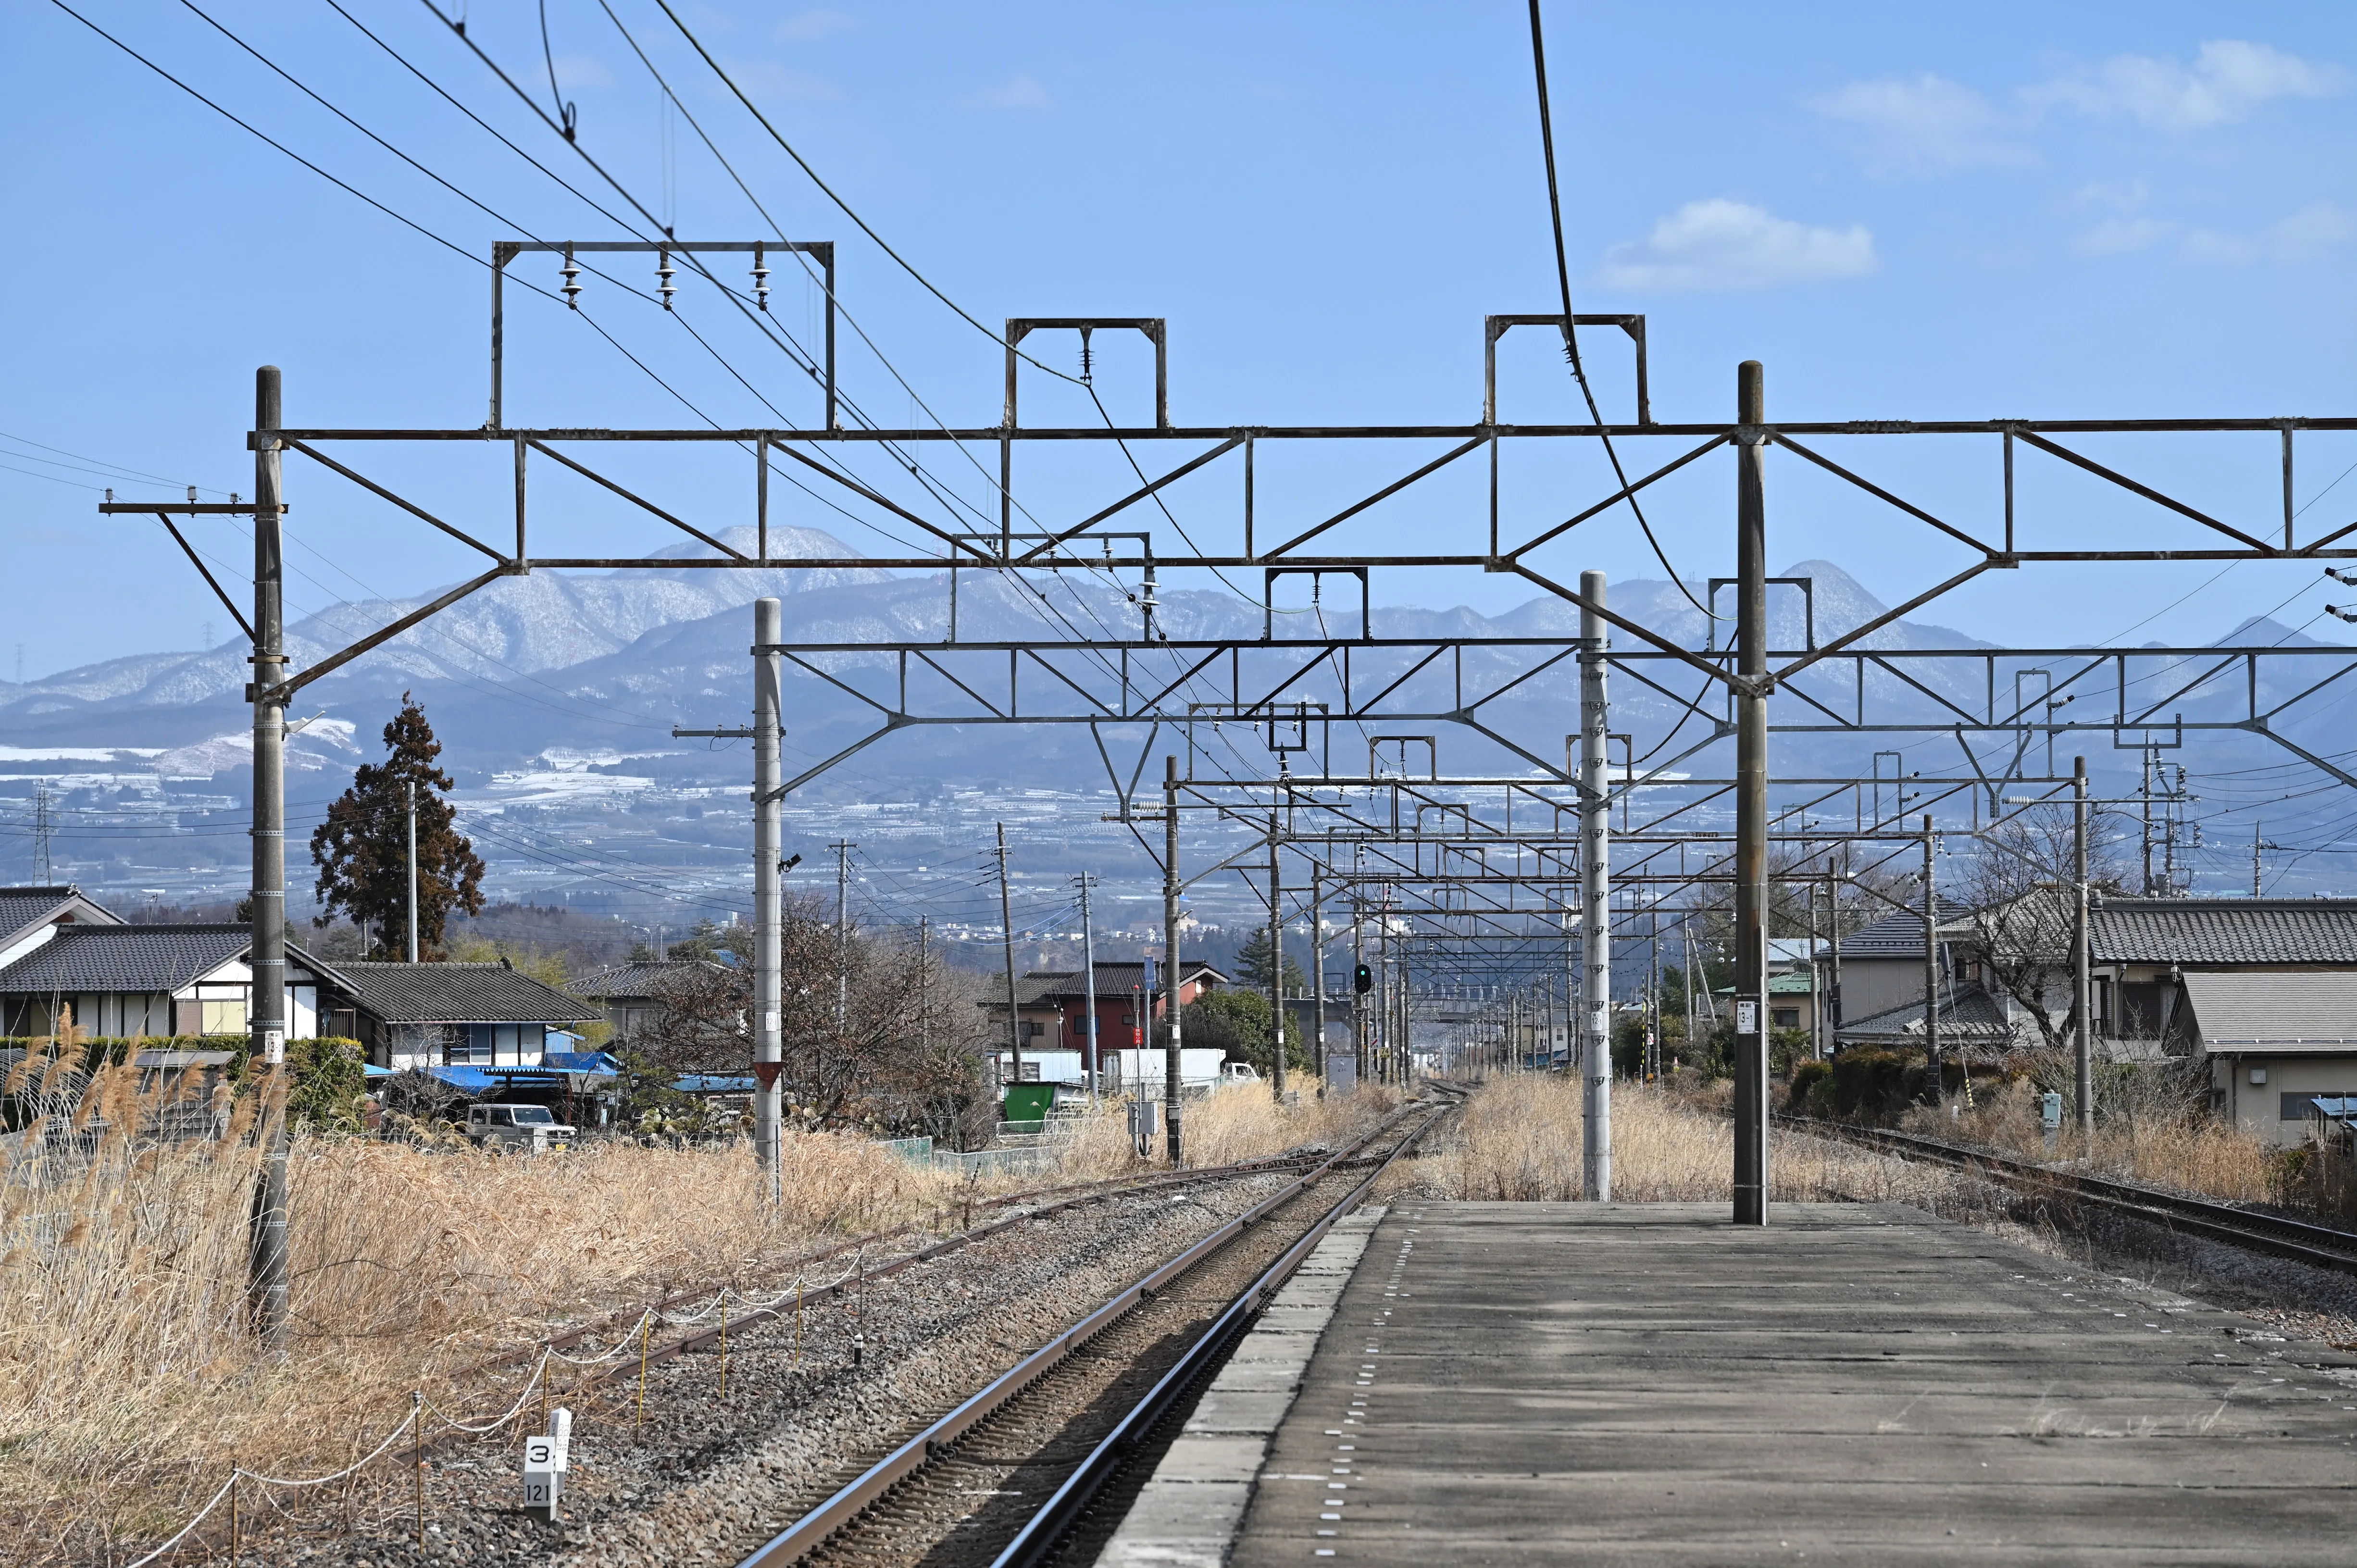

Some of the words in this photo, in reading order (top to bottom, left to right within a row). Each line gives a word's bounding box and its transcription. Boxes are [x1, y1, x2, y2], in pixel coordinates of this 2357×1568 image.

[1738, 1012, 1752, 1023] 13-1
[267, 1042, 281, 1053] 13-2
[529, 1445, 549, 1463] 3
[526, 1484, 549, 1501] 121
